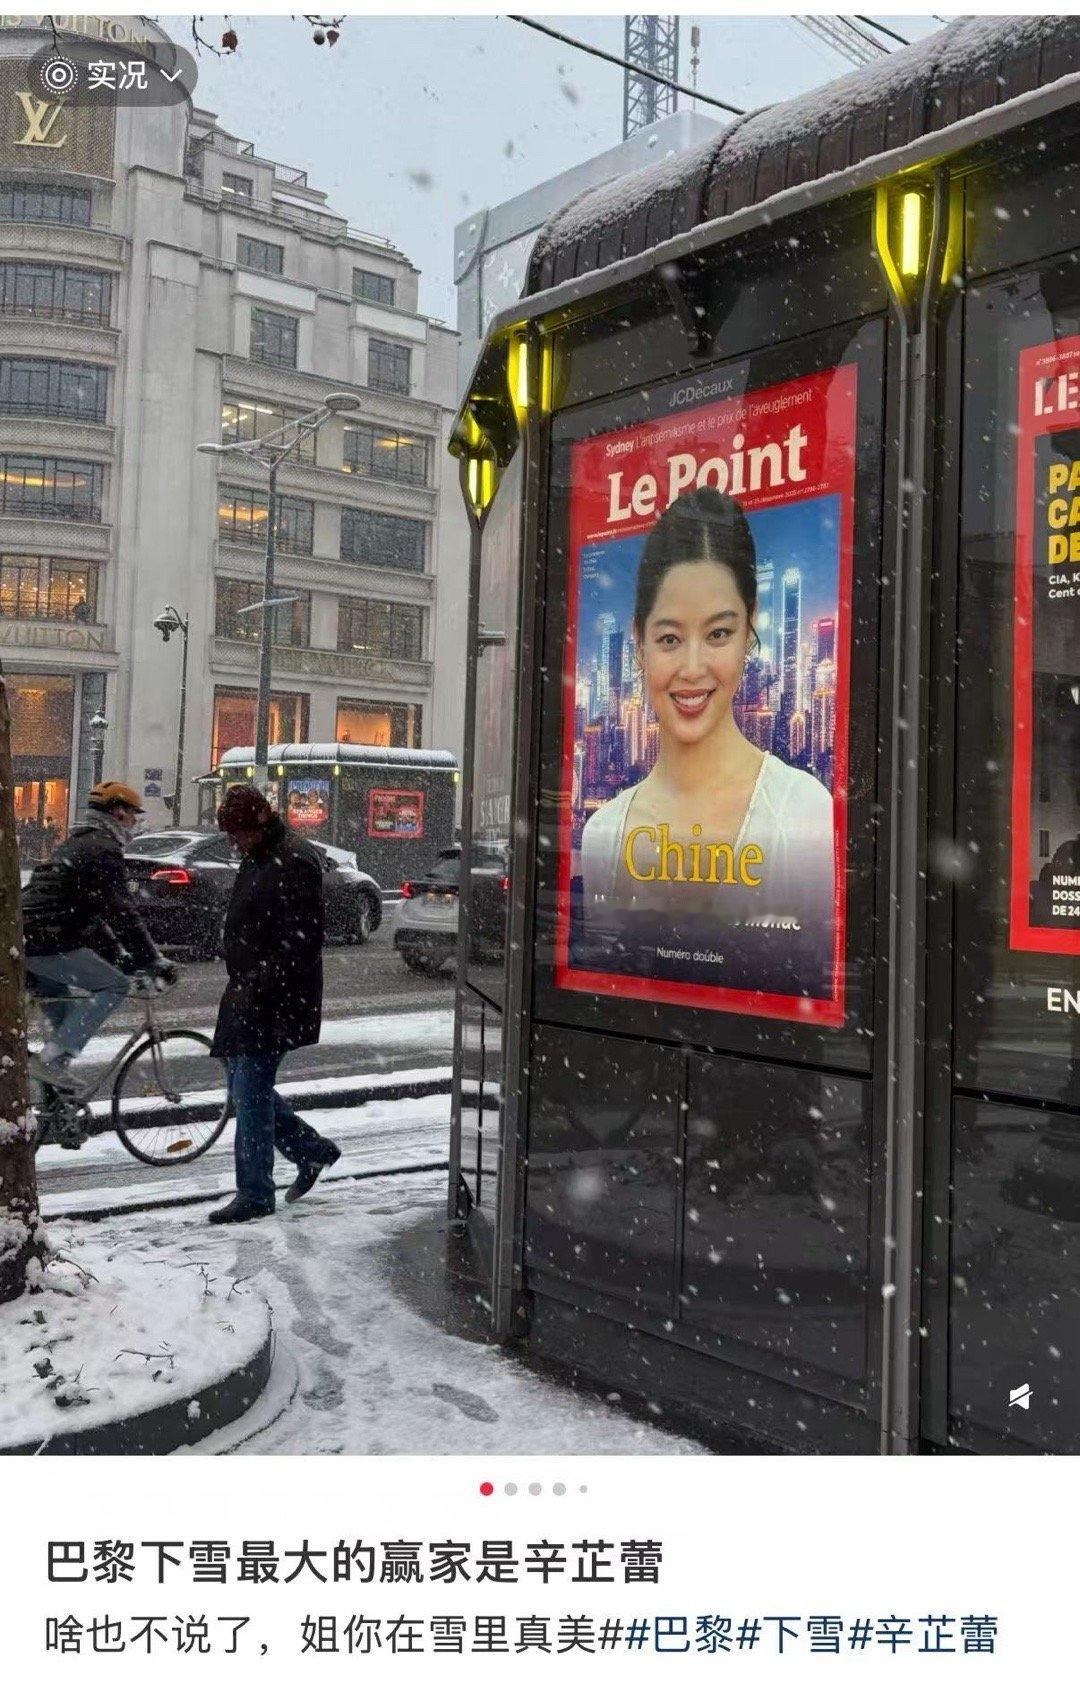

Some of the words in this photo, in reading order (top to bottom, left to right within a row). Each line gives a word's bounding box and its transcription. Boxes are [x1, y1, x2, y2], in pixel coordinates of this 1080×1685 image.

[606, 439, 635, 458] Sydney
[716, 412, 735, 431] prix
[606, 471, 658, 523] Le
[666, 423, 808, 510] Point
[1048, 575, 1070, 586] CIA,
[1048, 586, 1075, 599] Cent
[623, 823, 764, 887] Chine
[1052, 904, 1067, 916] DE
[657, 947, 691, 961] Numéro
[693, 950, 725, 964] double
